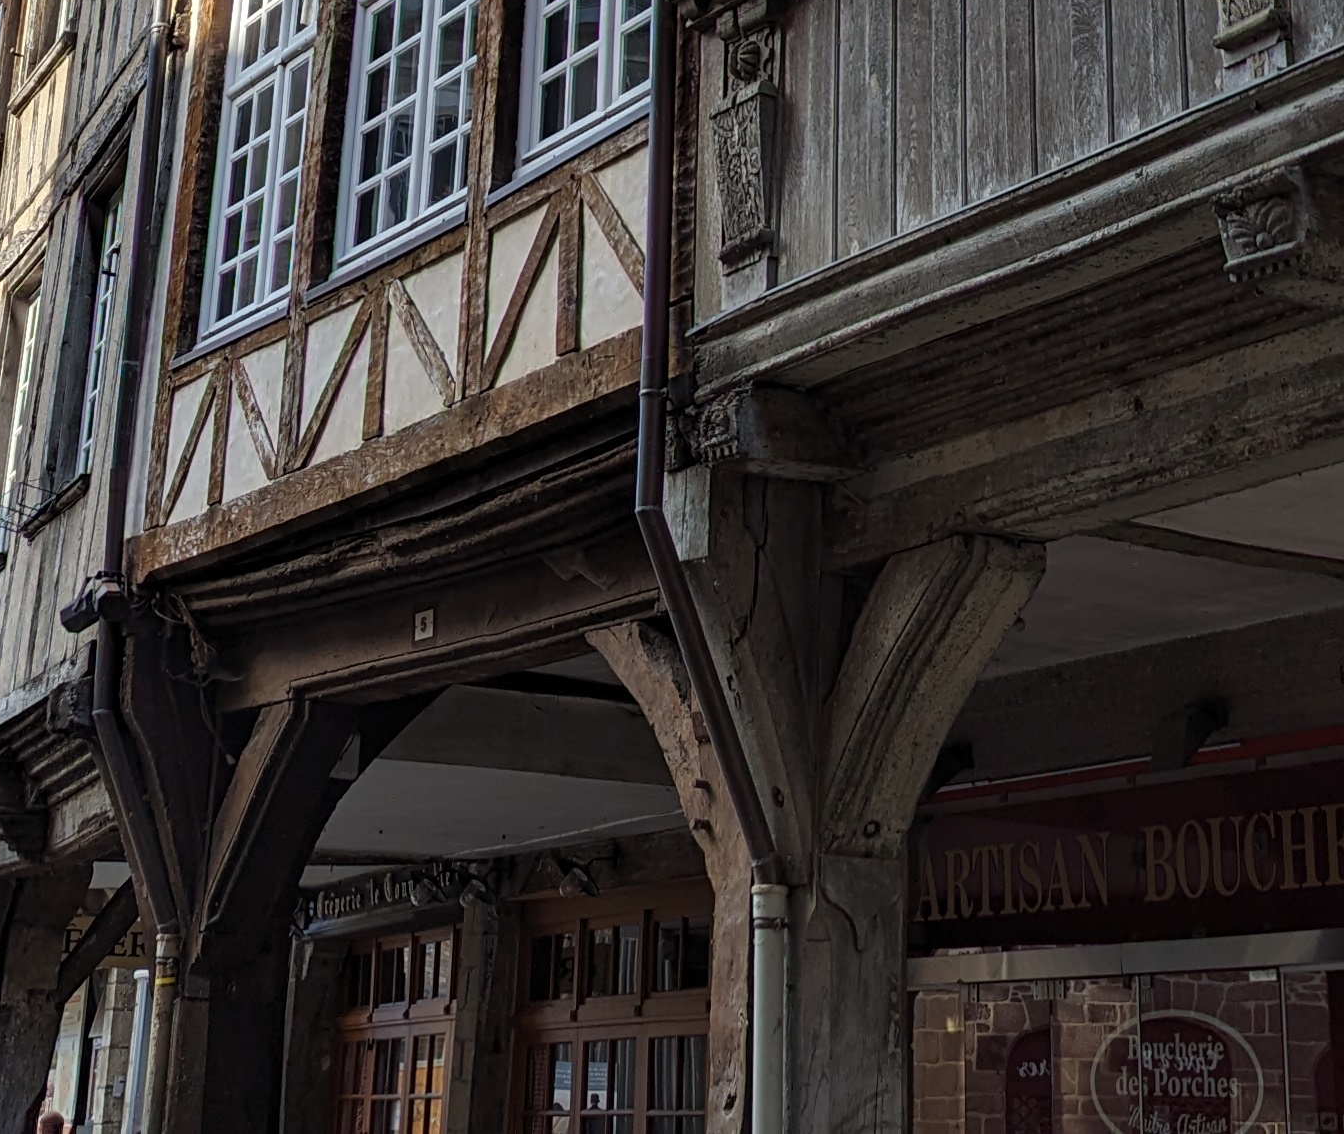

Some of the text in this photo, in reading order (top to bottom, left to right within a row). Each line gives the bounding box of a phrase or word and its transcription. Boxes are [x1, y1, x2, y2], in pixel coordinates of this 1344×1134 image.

[420, 616, 427, 633] 5
[914, 831, 1109, 922] ARTISAN
[316, 887, 361, 919] Crêperie
[1128, 1033, 1225, 1060] Boucherie
[1115, 1064, 1239, 1098] des Porches
